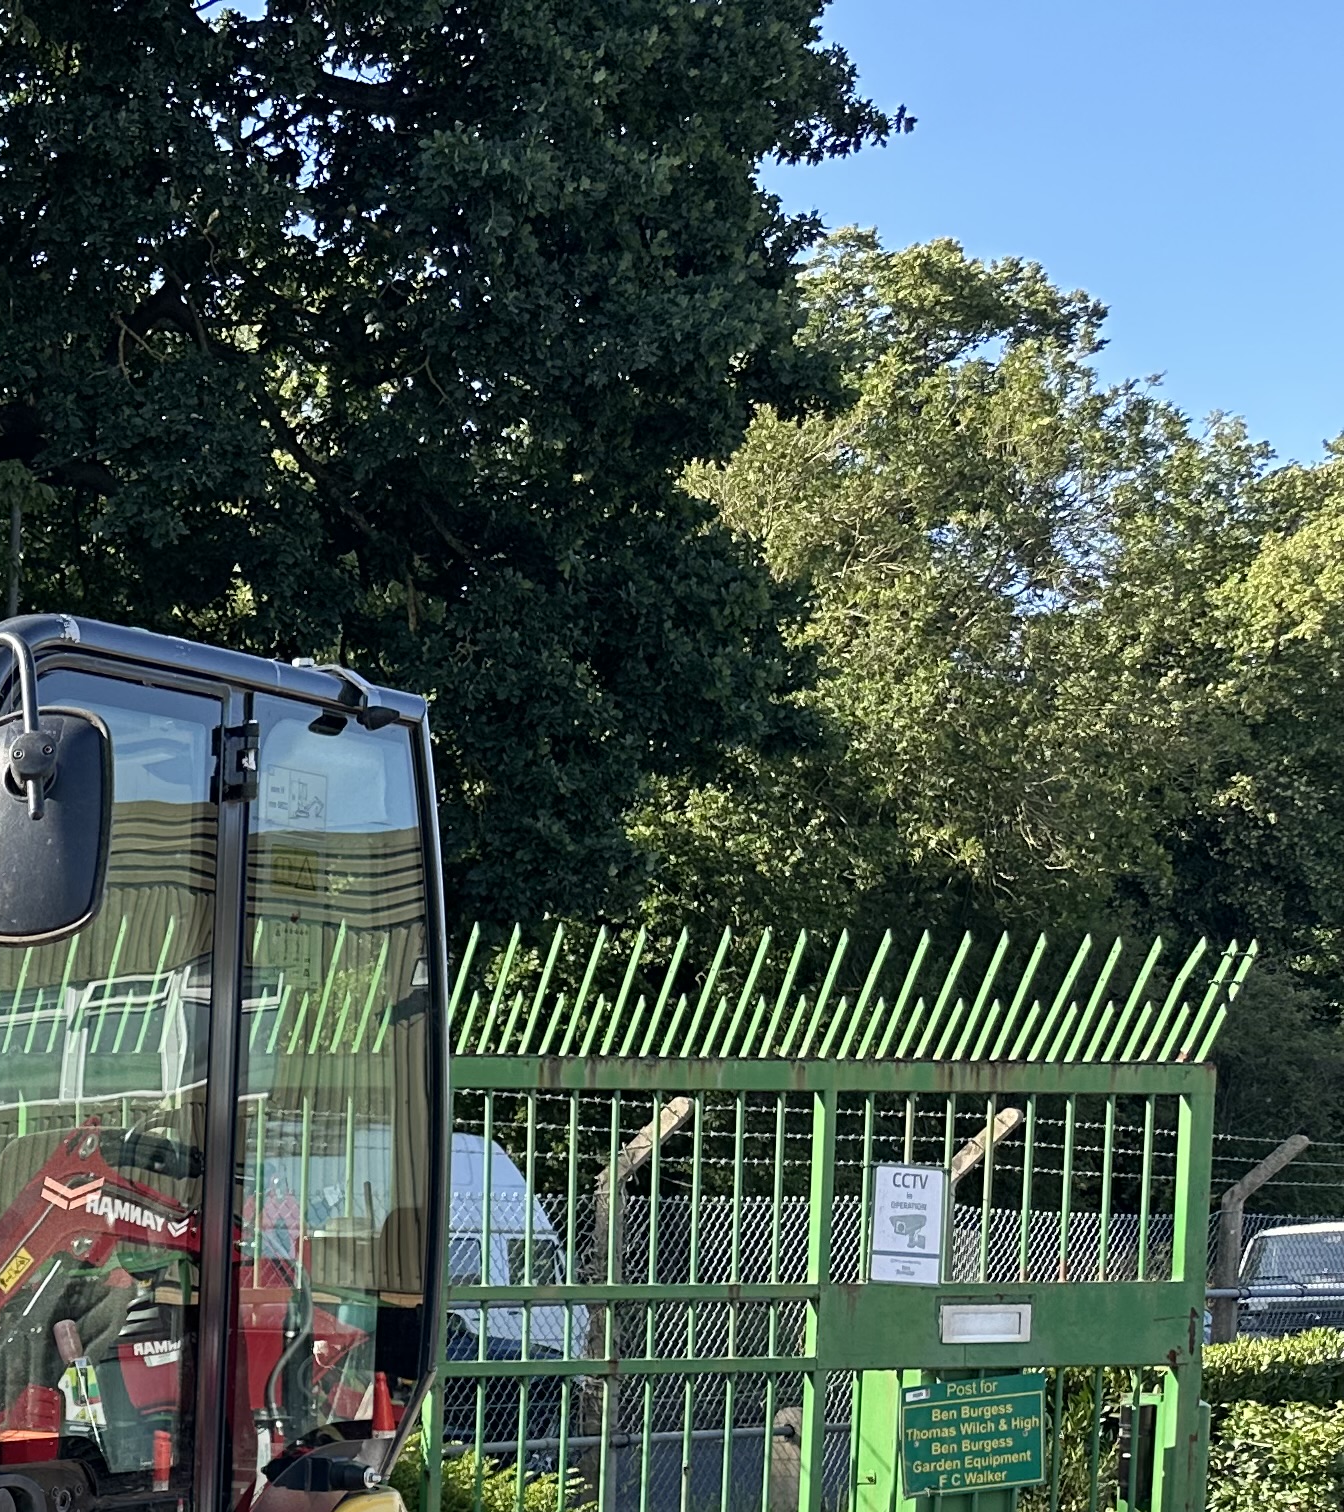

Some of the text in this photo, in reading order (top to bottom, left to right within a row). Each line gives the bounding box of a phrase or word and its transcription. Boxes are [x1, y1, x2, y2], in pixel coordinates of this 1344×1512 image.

[892, 1172, 929, 1189] CCTV
[890, 1201, 927, 1211] OPERATION
[947, 1380, 998, 1397] Post for
[932, 1403, 1013, 1421] Ben Burgess
[906, 1416, 1039, 1440] Thomas Wilch & High
[932, 1437, 1013, 1455] Ben Burgess
[912, 1450, 1031, 1473] Garden Equipment
[939, 1470, 1007, 1487] F C Walker
